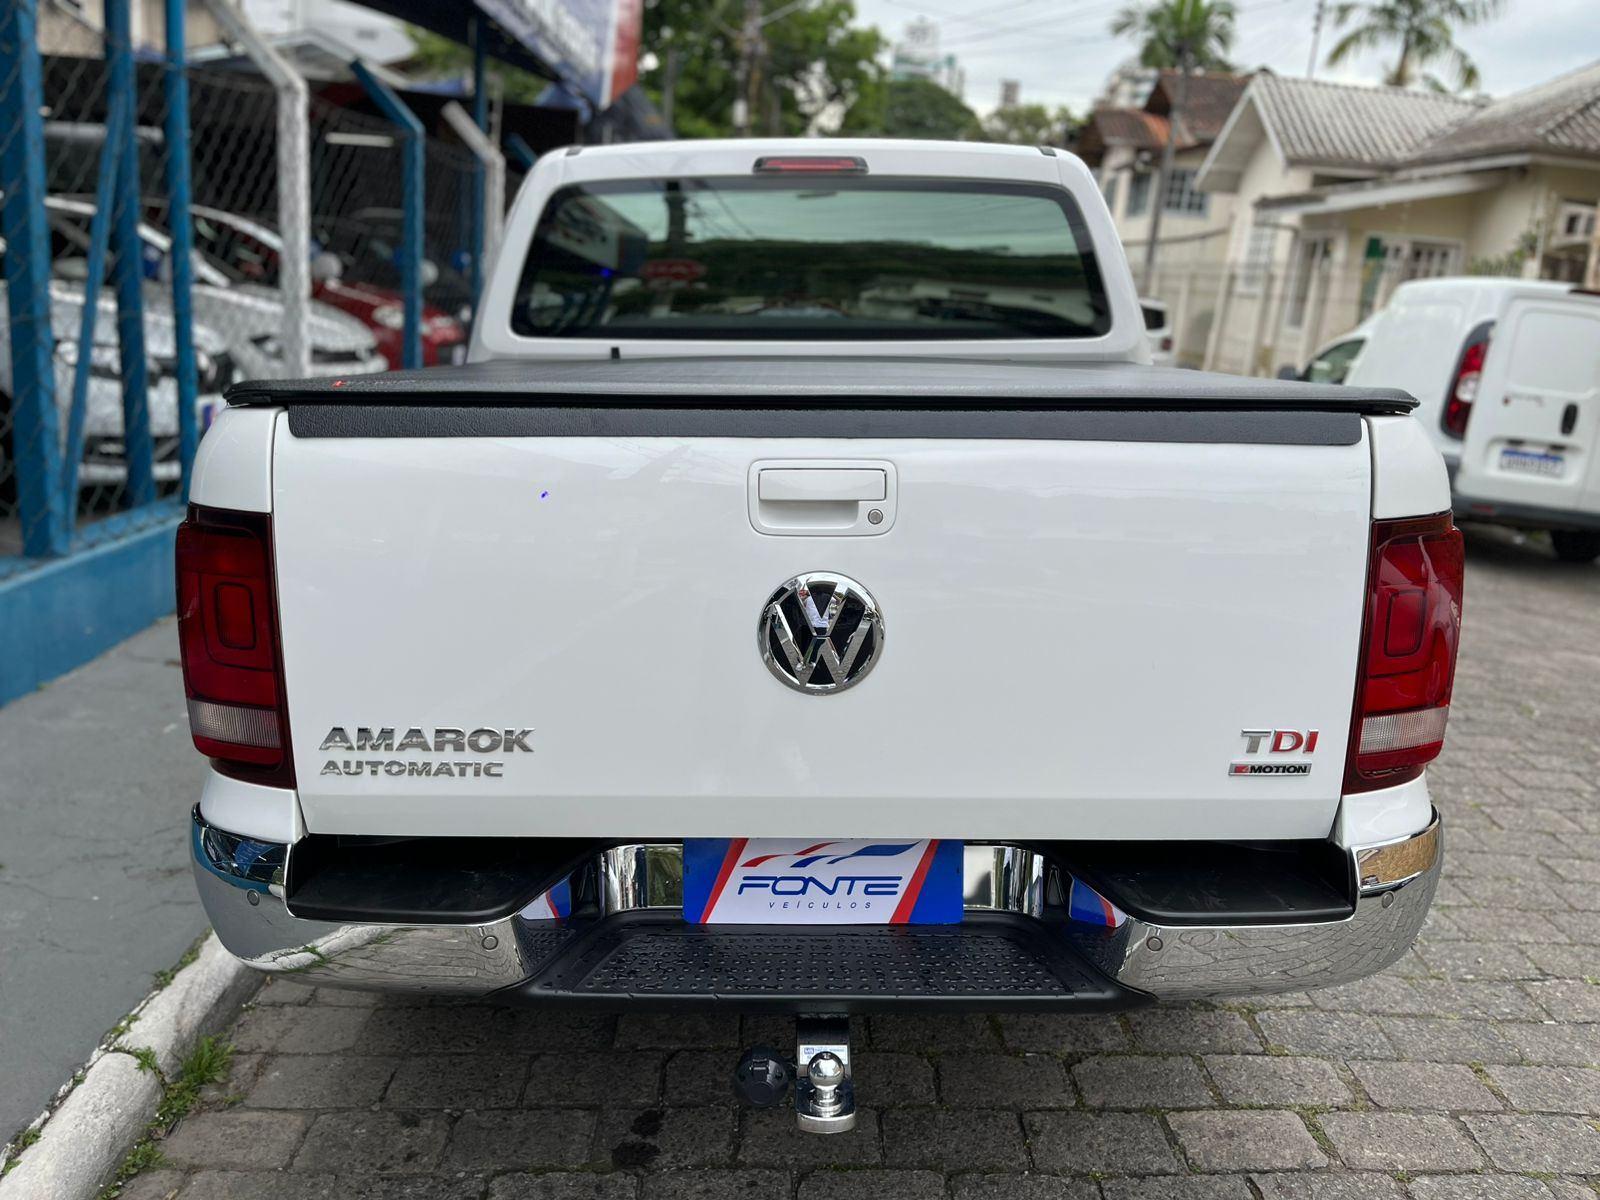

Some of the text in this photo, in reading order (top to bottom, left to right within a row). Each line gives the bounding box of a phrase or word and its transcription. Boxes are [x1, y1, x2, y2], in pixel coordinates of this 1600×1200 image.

[318, 726, 535, 753] AMAROK
[1240, 728, 1319, 754] TDI
[319, 760, 504, 777] AUTOMATIC
[737, 875, 903, 896] FONTE
[768, 899, 872, 909] VEÍCULOS
